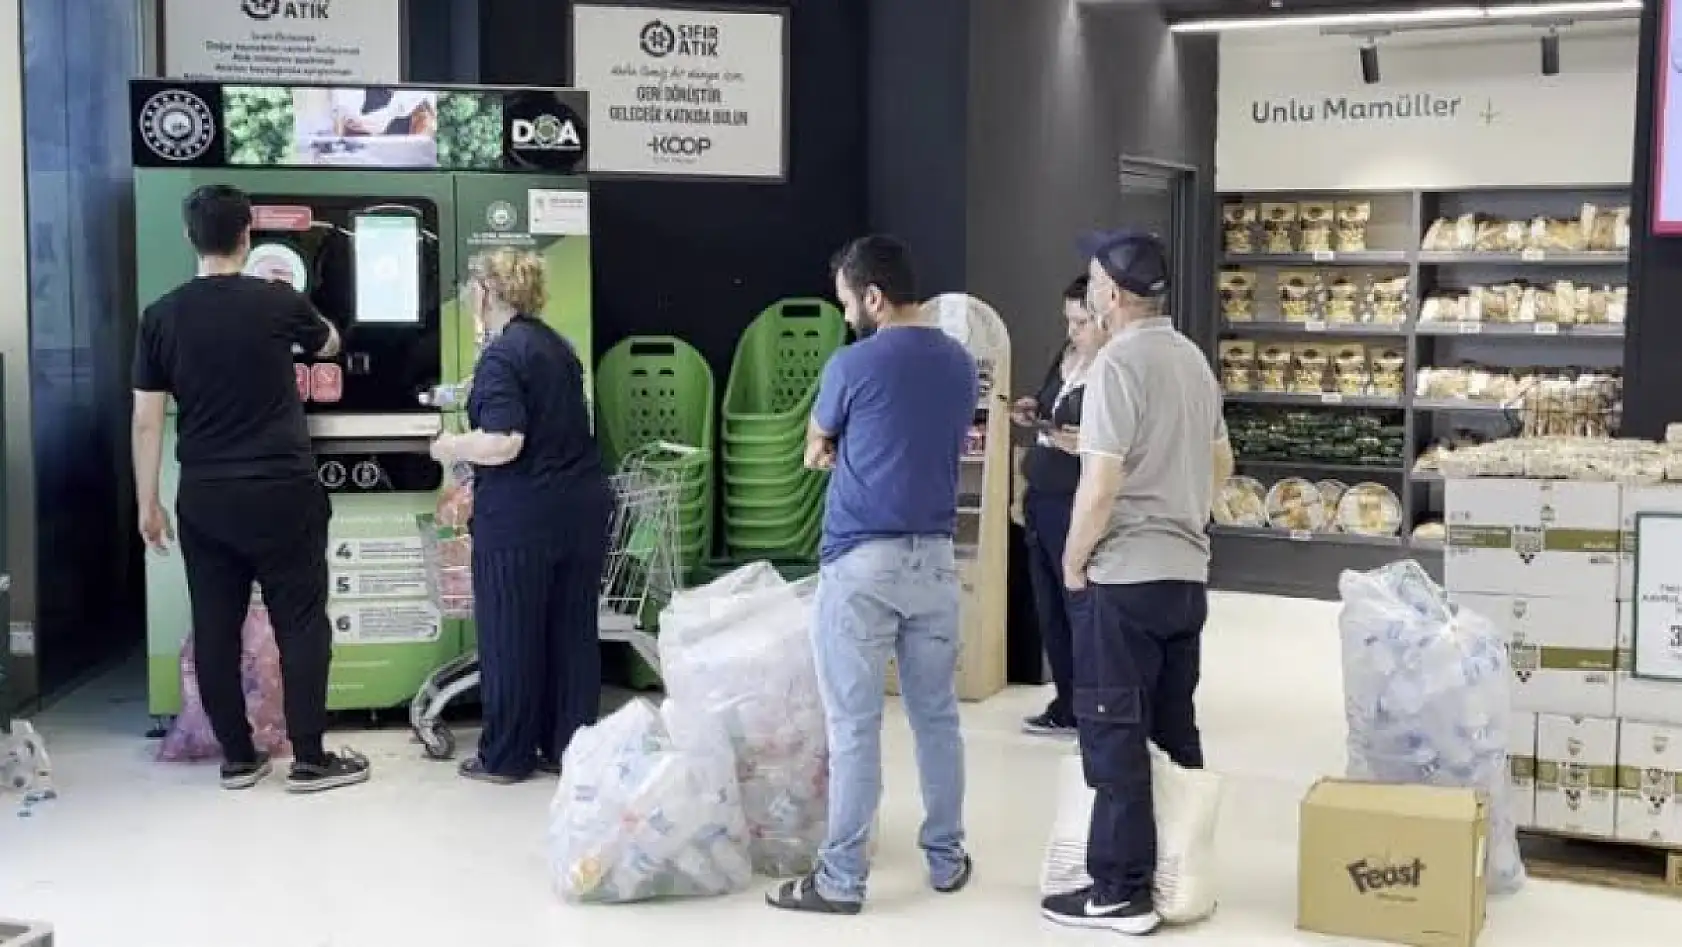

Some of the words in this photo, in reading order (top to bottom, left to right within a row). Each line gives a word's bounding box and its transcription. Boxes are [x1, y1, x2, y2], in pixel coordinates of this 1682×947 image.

[283, 2, 329, 19] ATIK
[677, 24, 718, 40] SIFIR
[677, 41, 718, 56] ATIK
[1252, 97, 1315, 124] Unlu
[1322, 93, 1462, 120] Mamüller
[335, 542, 352, 560] 4
[336, 576, 351, 594] 5
[335, 615, 352, 633] 6
[1346, 857, 1427, 895] Feast
